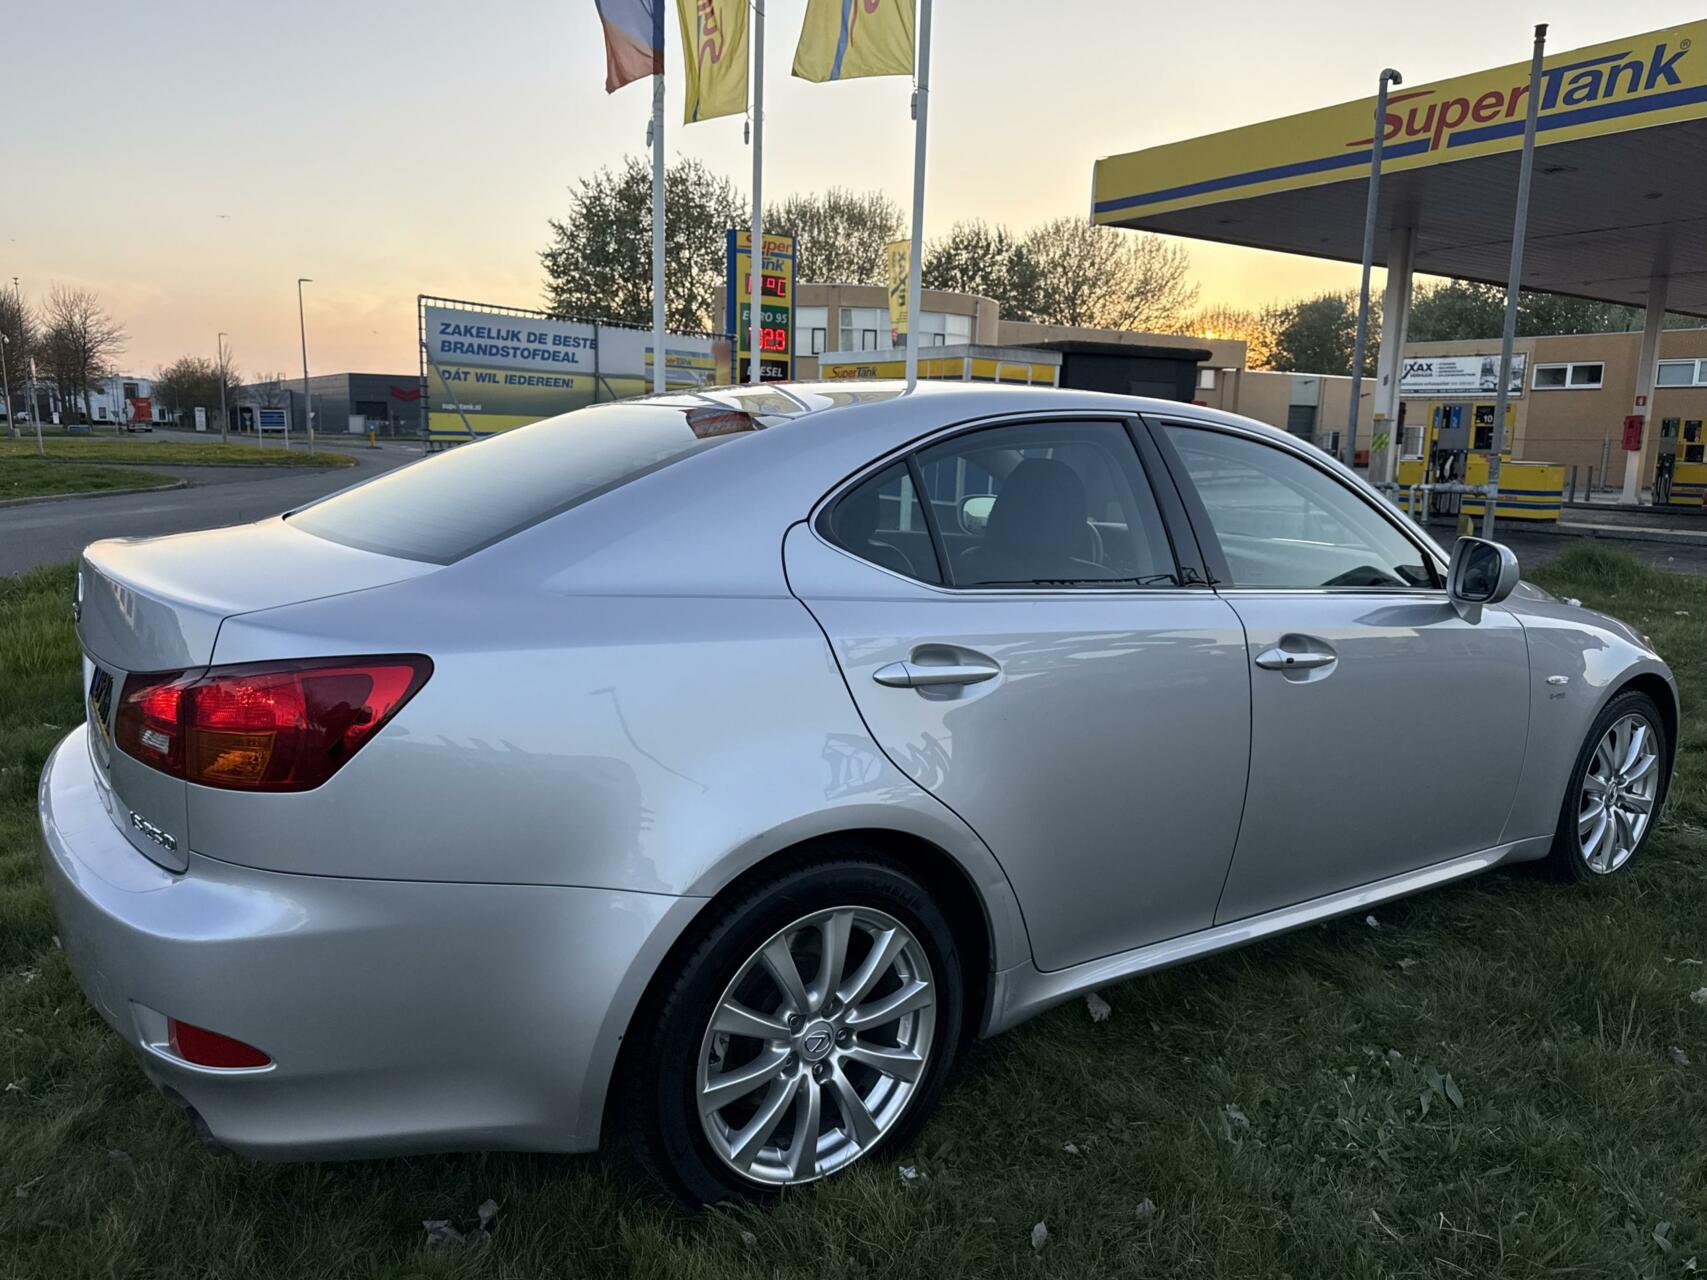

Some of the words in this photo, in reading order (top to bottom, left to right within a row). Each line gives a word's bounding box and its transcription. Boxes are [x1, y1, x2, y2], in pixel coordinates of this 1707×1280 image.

[739, 235, 790, 256] Sper
[743, 311, 773, 323] ERO
[776, 313, 788, 324] 95
[440, 322, 522, 342] ZAKELIJK
[527, 331, 548, 345] DE
[552, 334, 597, 350] BESTE
[441, 340, 579, 363] BRANDSTOFDEAL
[442, 368, 470, 382] DÁT
[475, 371, 500, 384] WIL
[504, 373, 573, 389] IEDEREEN!
[747, 366, 782, 377] DESEL
[1484, 415, 1493, 423] 10
